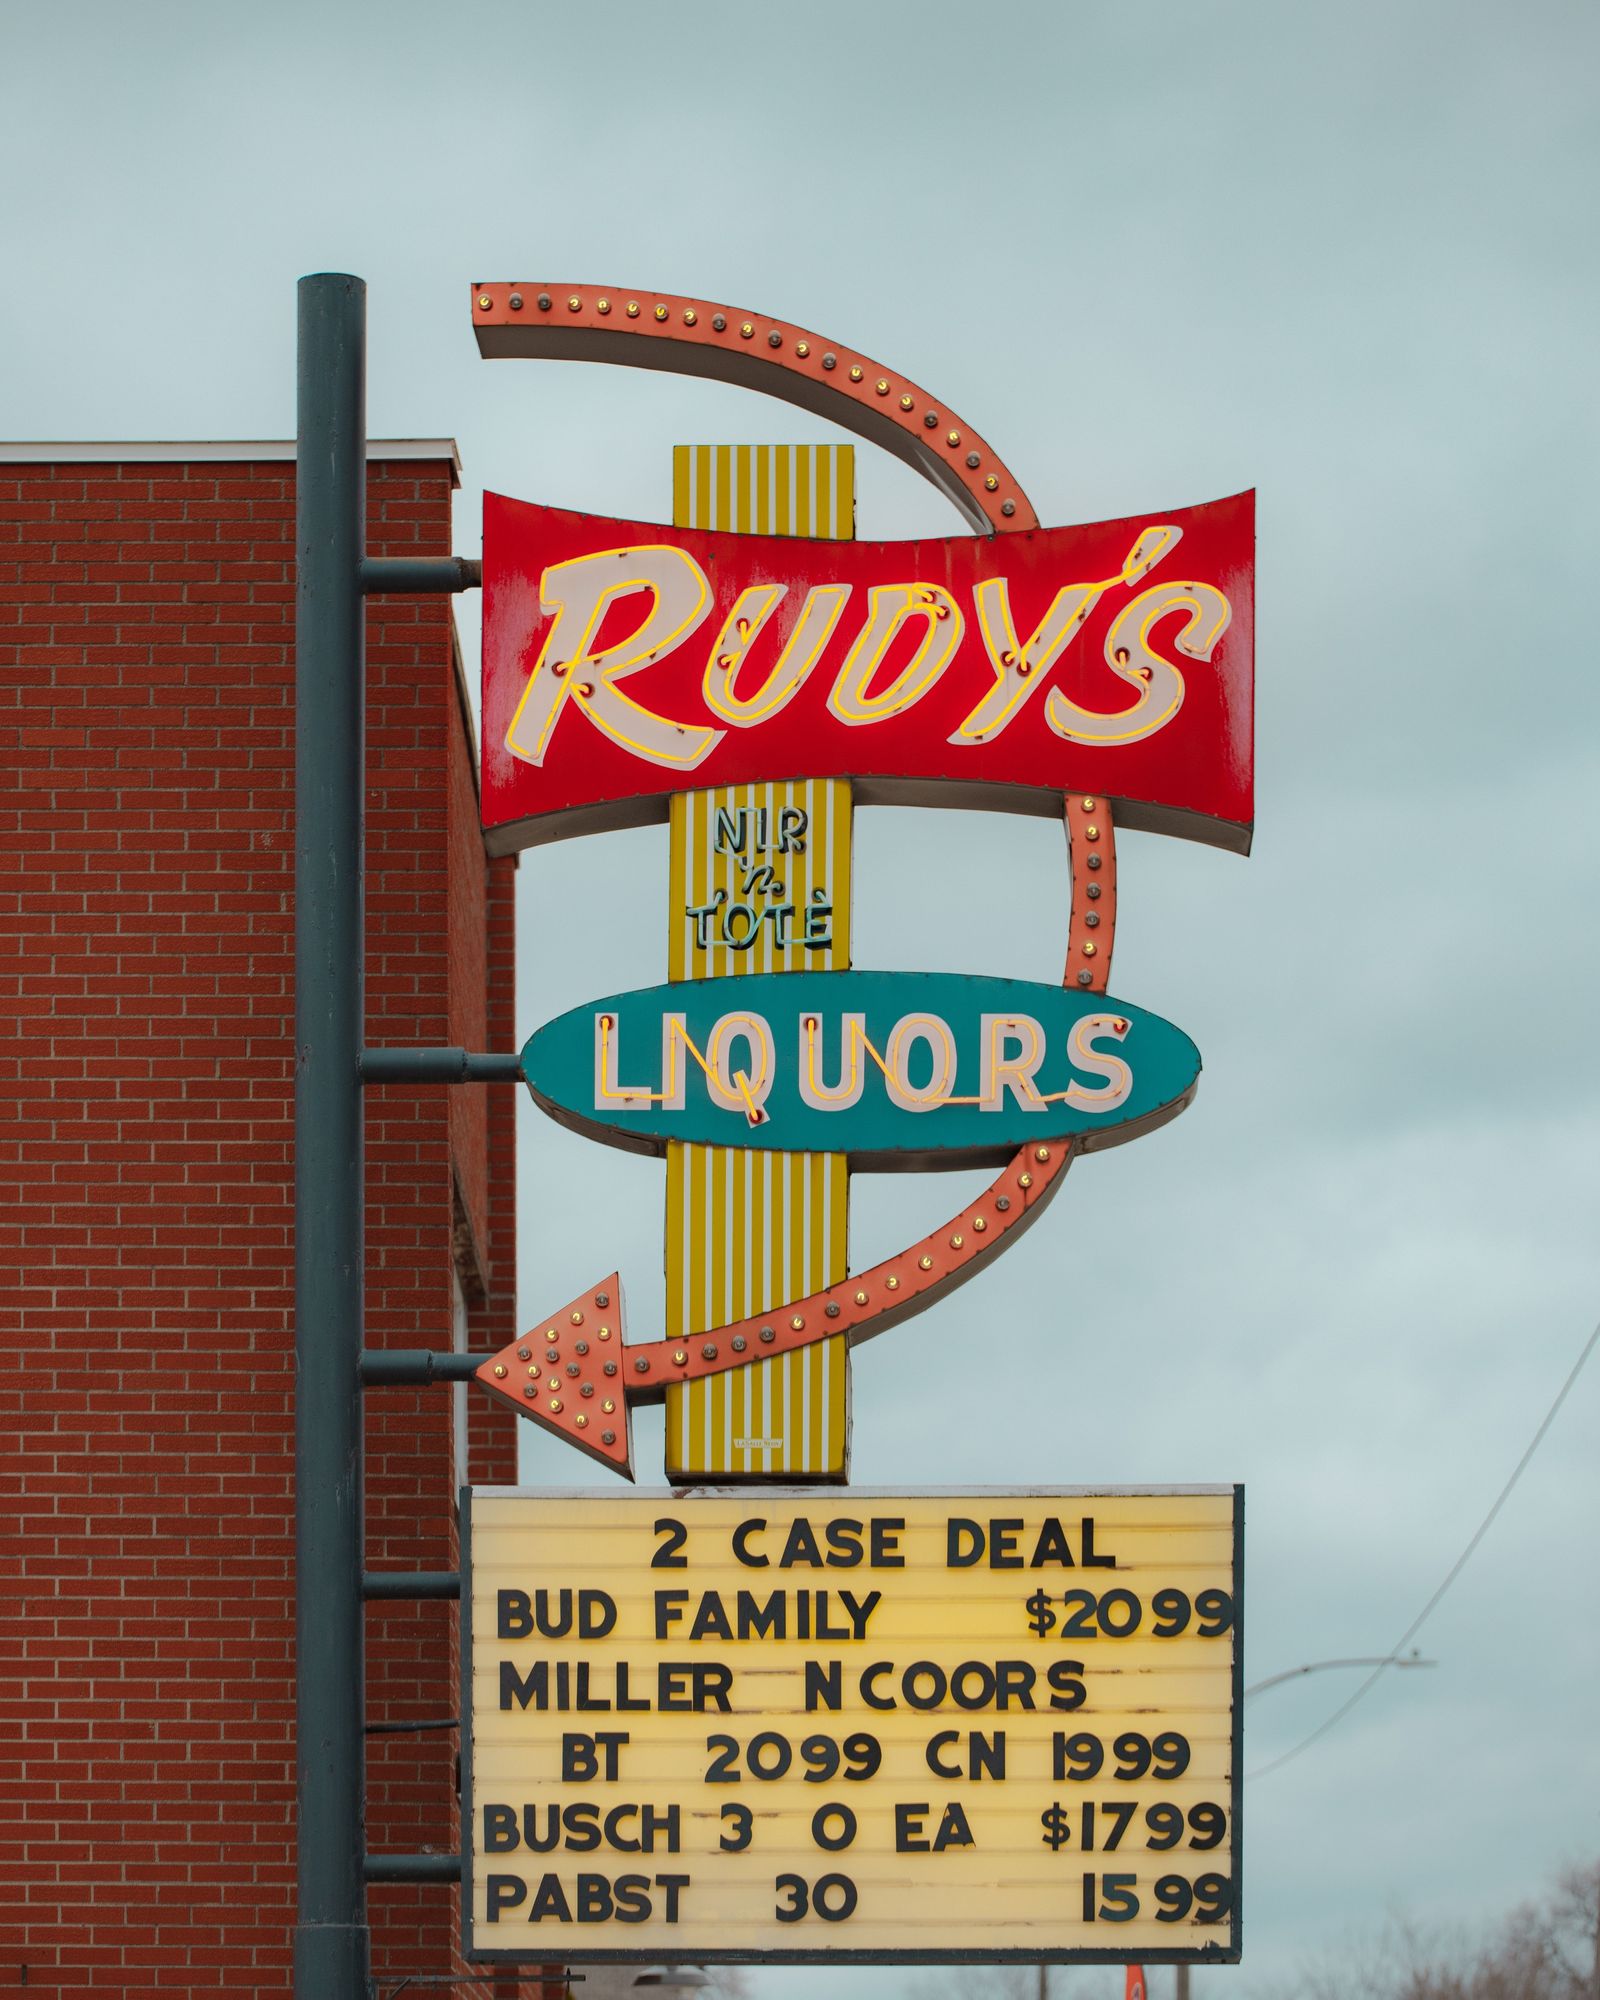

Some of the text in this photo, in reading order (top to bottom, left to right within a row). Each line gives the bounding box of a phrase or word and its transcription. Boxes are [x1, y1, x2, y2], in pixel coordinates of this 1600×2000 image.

[504, 525, 1232, 771] RUDY'S
[714, 806, 808, 854] NIR
[686, 902, 832, 950] TOTE
[594, 1011, 1133, 1128] LIQUORS
[650, 1517, 1116, 1568] 2 CASE DEAL
[497, 1588, 617, 1639] BUD
[654, 1589, 882, 1640] FAMILY
[499, 1660, 733, 1712] MILLER
[562, 1730, 1191, 1783] BT 2099 CN 1999
[483, 1802, 680, 1853] BUSCH
[894, 1802, 976, 1853] EA
[486, 1873, 690, 1923] PABST
